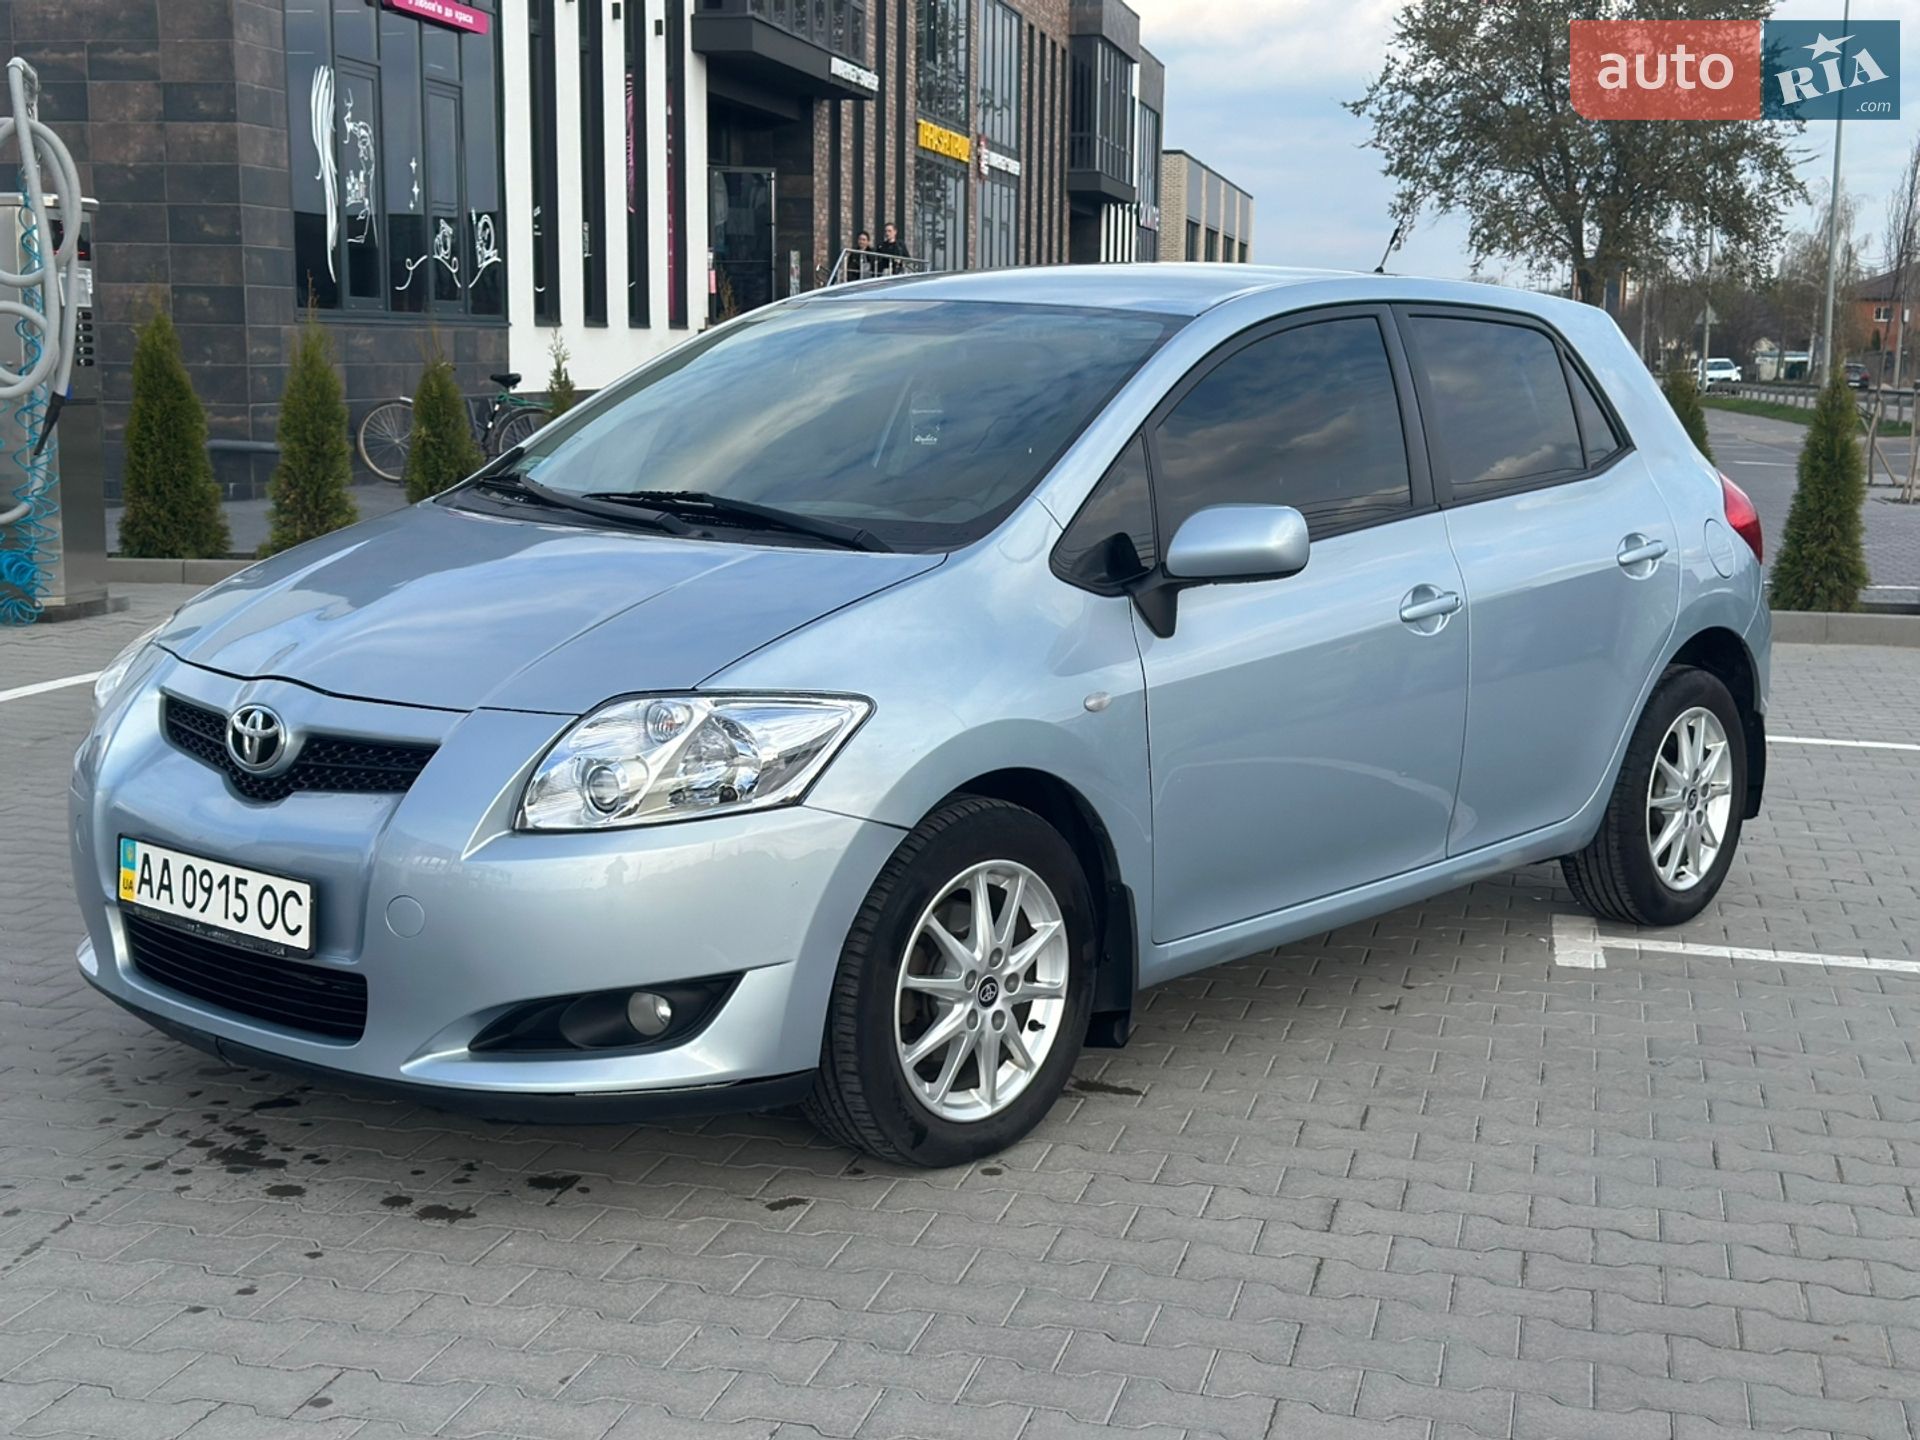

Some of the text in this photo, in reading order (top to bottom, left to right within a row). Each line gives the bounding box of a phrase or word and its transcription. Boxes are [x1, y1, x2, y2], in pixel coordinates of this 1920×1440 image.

[122, 878, 134, 891] UA
[136, 852, 303, 936] AA 0915 OC
